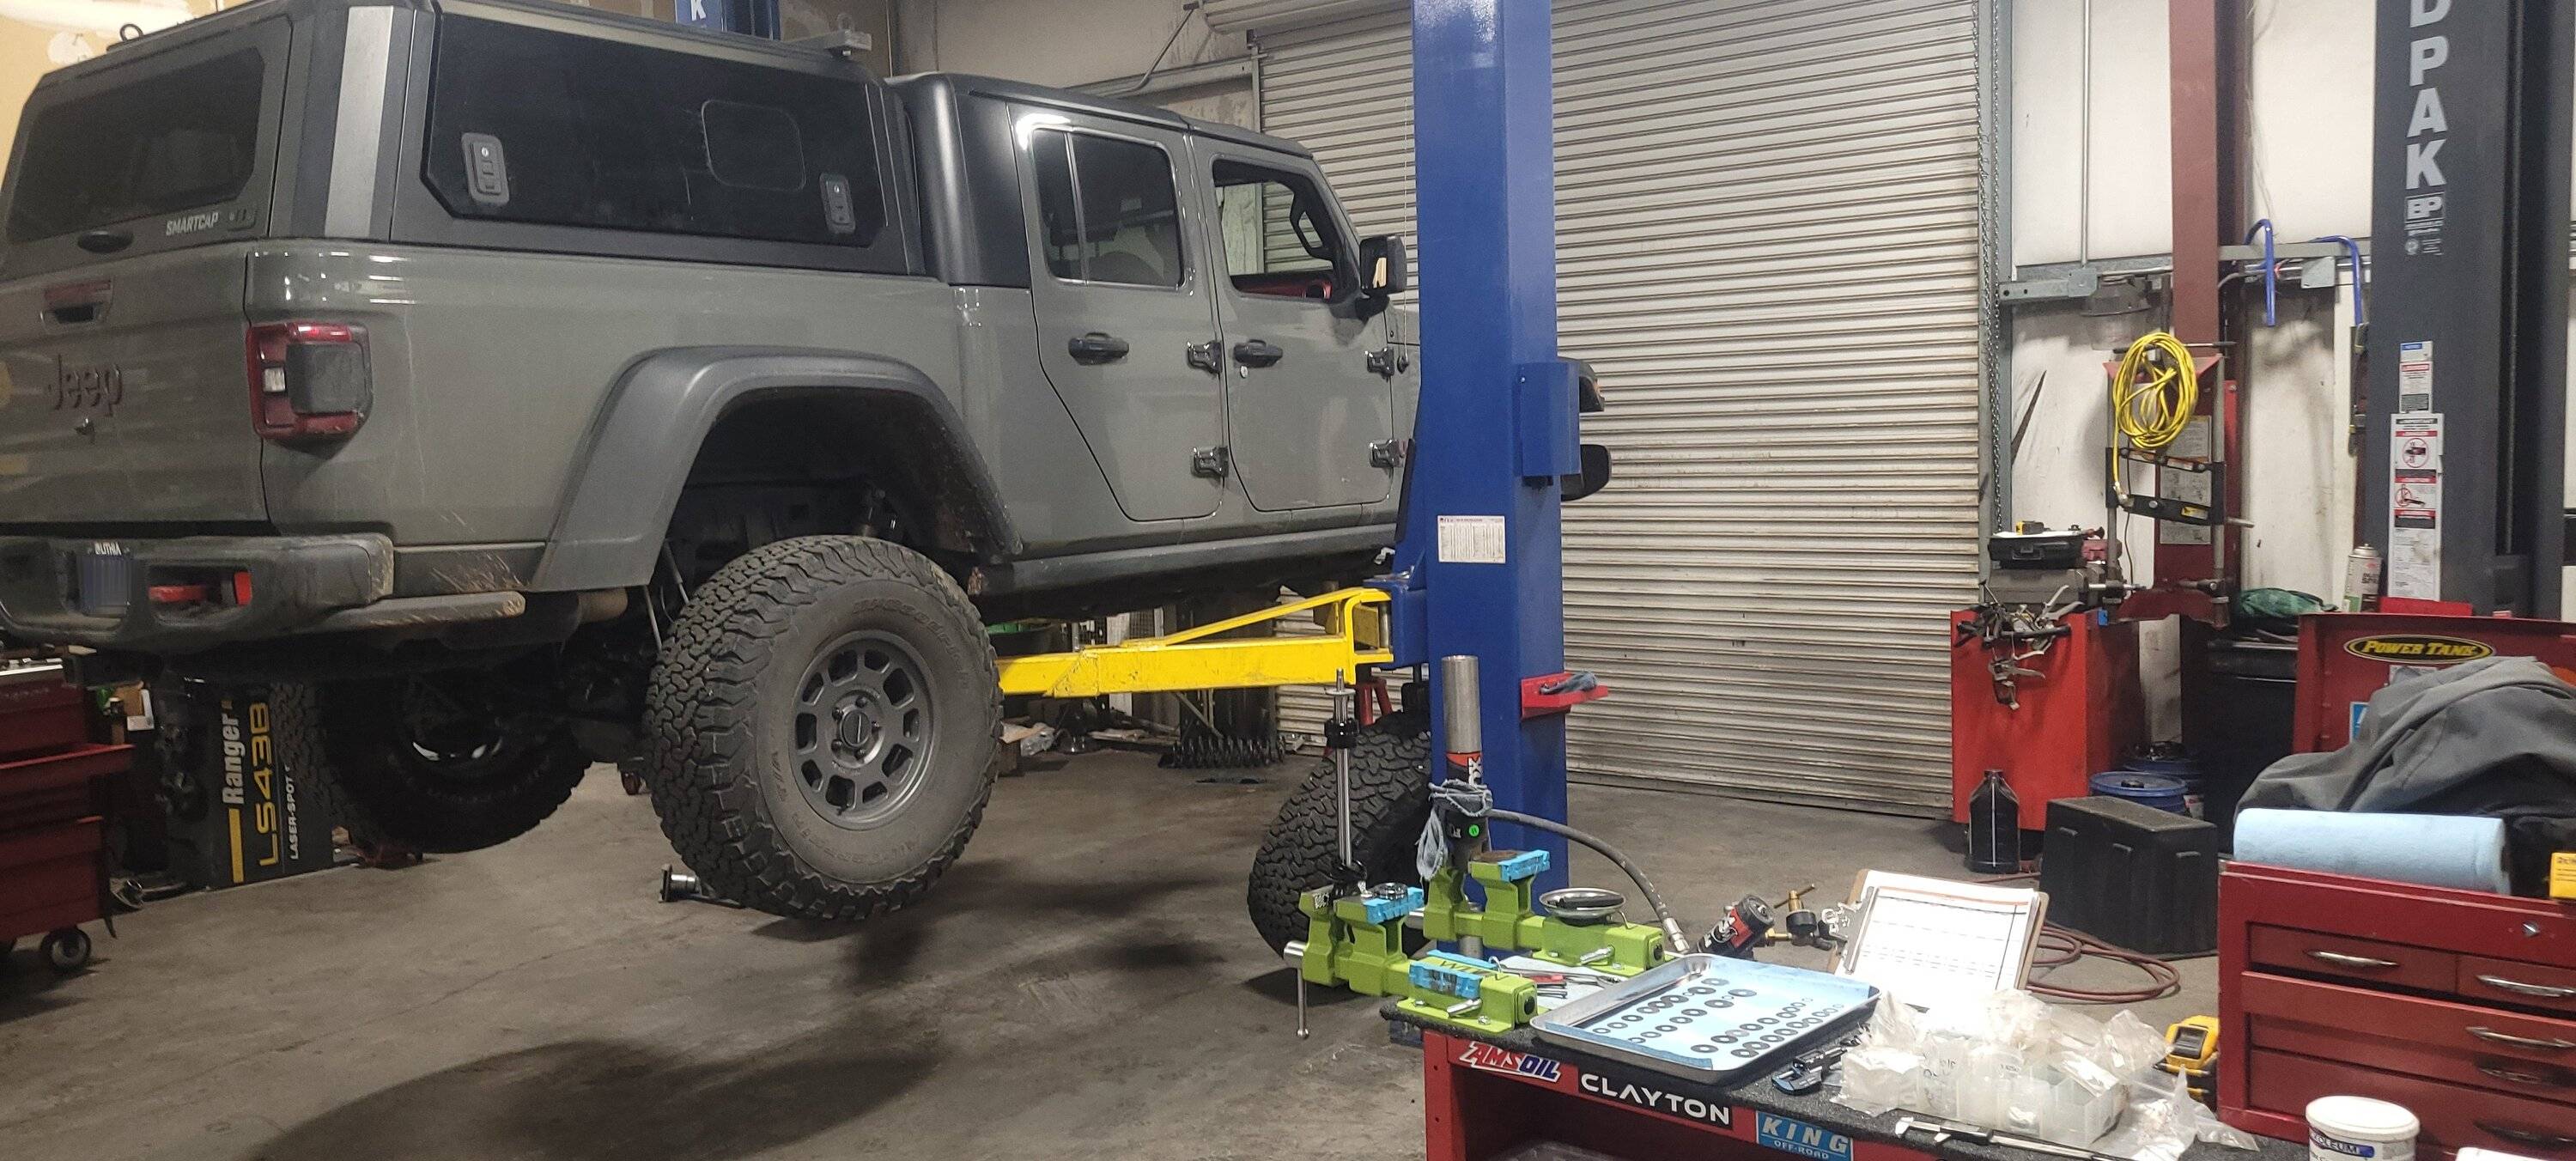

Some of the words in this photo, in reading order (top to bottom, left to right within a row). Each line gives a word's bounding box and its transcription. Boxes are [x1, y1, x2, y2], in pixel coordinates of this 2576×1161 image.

[165, 211, 220, 236] SMARTCAP
[2407, 196, 2443, 219] BP
[48, 354, 123, 417] Jeep
[2361, 640, 2425, 655] POWER
[2425, 642, 2477, 656] TANK
[222, 713, 246, 805] Ranger
[249, 702, 279, 866] LS43B
[285, 775, 300, 860] LASER-SPOT
[1460, 1041, 1562, 1083] AMSOIL
[1580, 1073, 1729, 1126] CLAYTON
[1762, 1116, 1850, 1154] KING
[1773, 1140, 1830, 1159] OFF-ROAD
